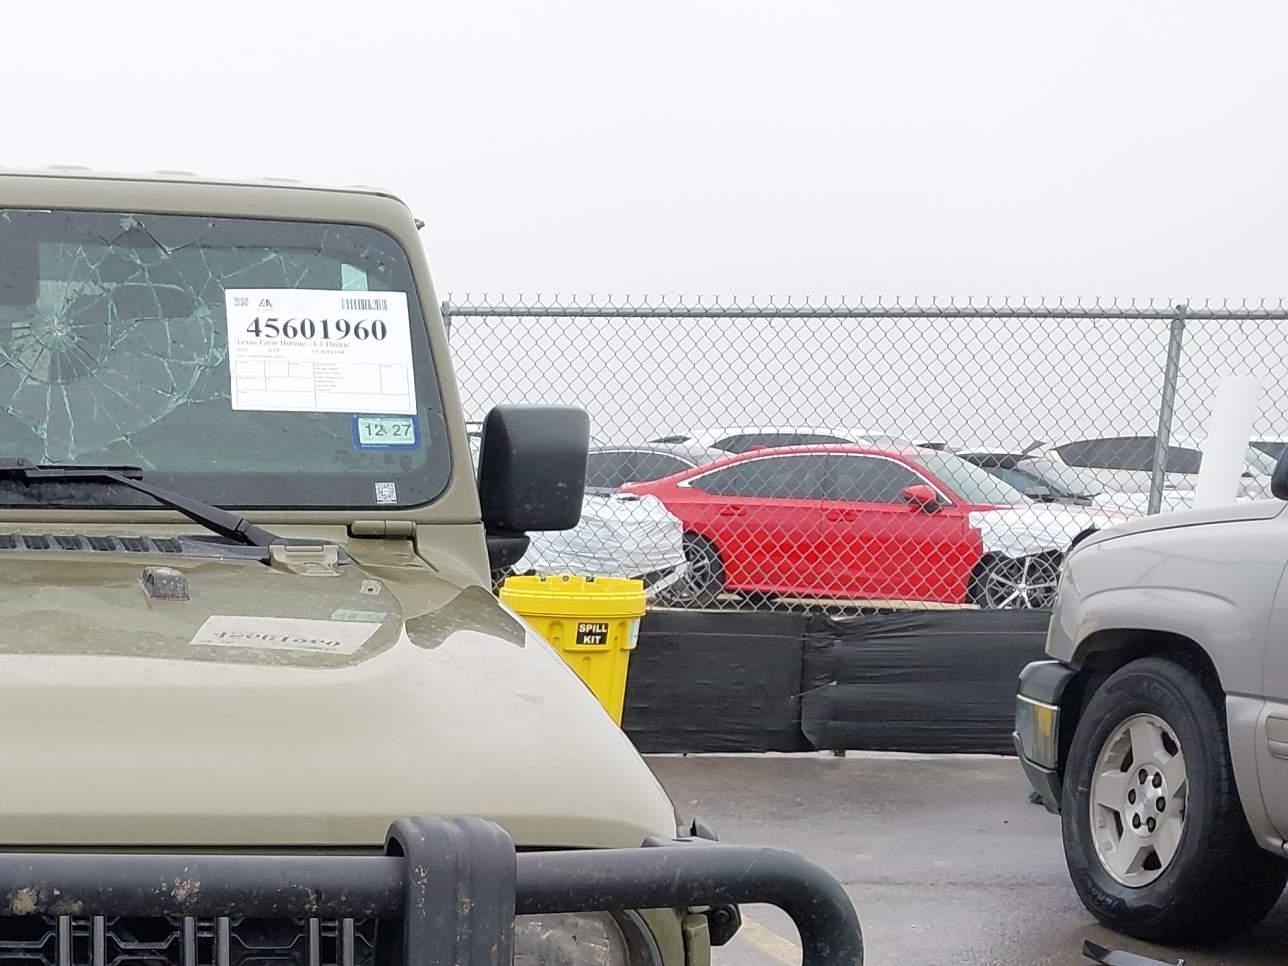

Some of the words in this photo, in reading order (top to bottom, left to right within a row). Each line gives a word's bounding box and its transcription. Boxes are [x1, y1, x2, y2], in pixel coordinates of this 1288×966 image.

[246, 316, 387, 341] 45601960
[392, 423, 412, 437] 27
[578, 623, 608, 634] SPILL
[583, 634, 602, 644] KIT
